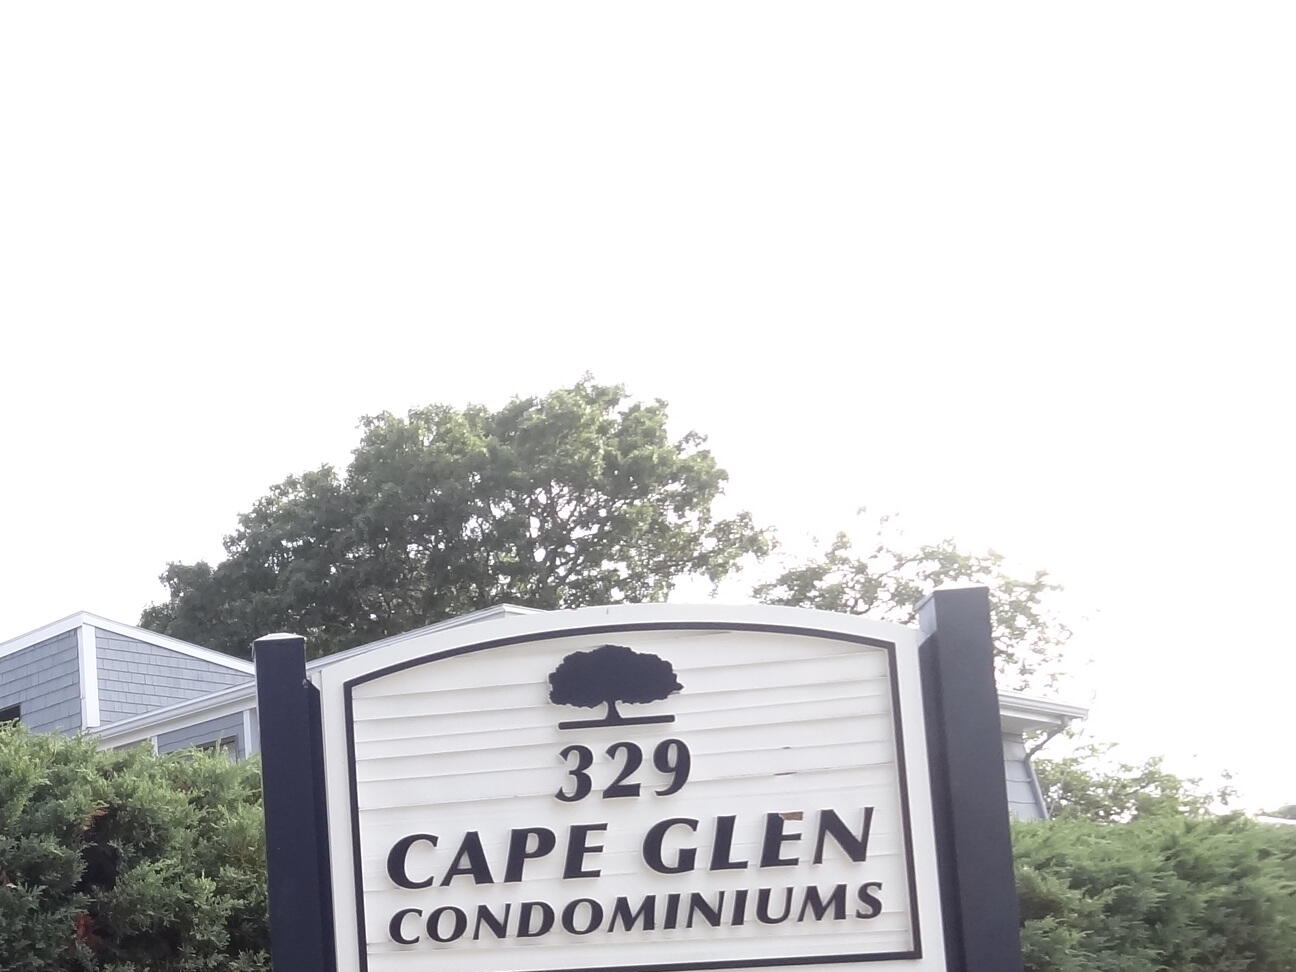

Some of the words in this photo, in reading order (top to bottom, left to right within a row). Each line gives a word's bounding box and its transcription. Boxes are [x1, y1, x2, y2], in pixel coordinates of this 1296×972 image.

[555, 738, 692, 802] 329
[386, 822, 608, 890] CAPE
[642, 806, 874, 874] GLEN
[389, 881, 883, 945] CONDOMINIUMS
